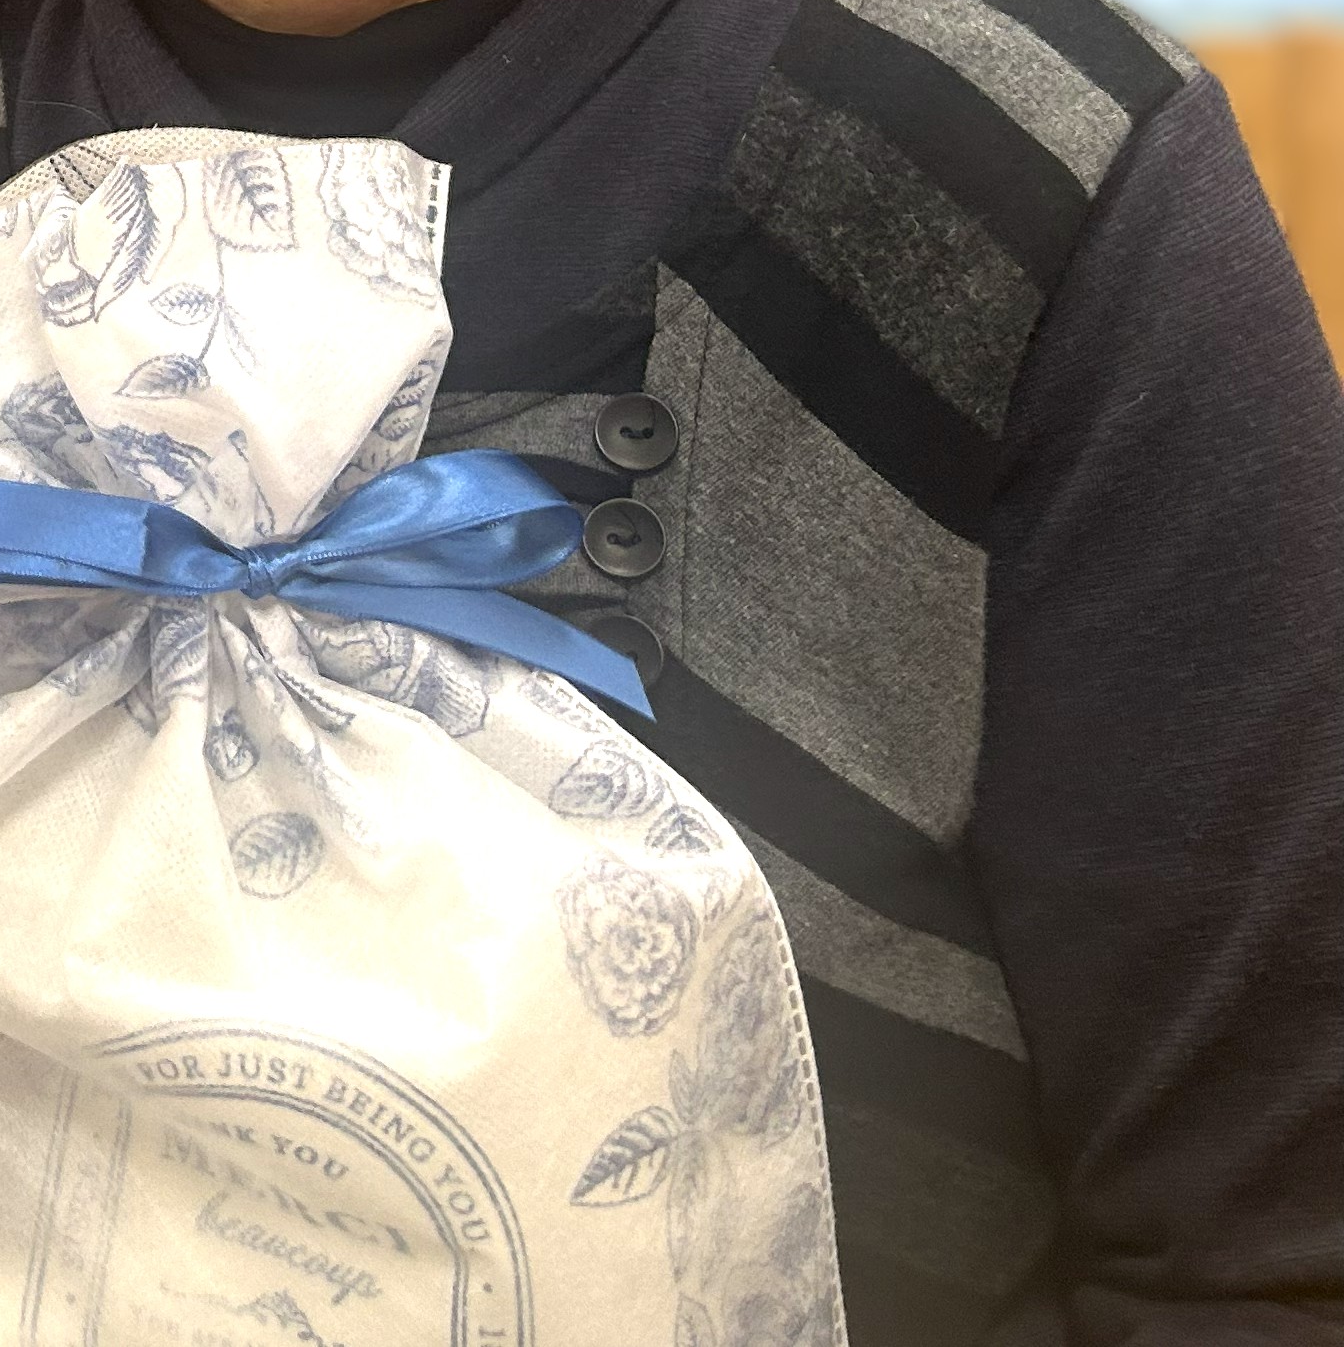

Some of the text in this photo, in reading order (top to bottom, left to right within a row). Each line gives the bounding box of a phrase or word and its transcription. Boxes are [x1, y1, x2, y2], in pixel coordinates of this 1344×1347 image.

[217, 1052, 313, 1090] JUST
[324, 1075, 437, 1163] BEING
[433, 1163, 490, 1242] YOU
[270, 1133, 351, 1181] YOU
